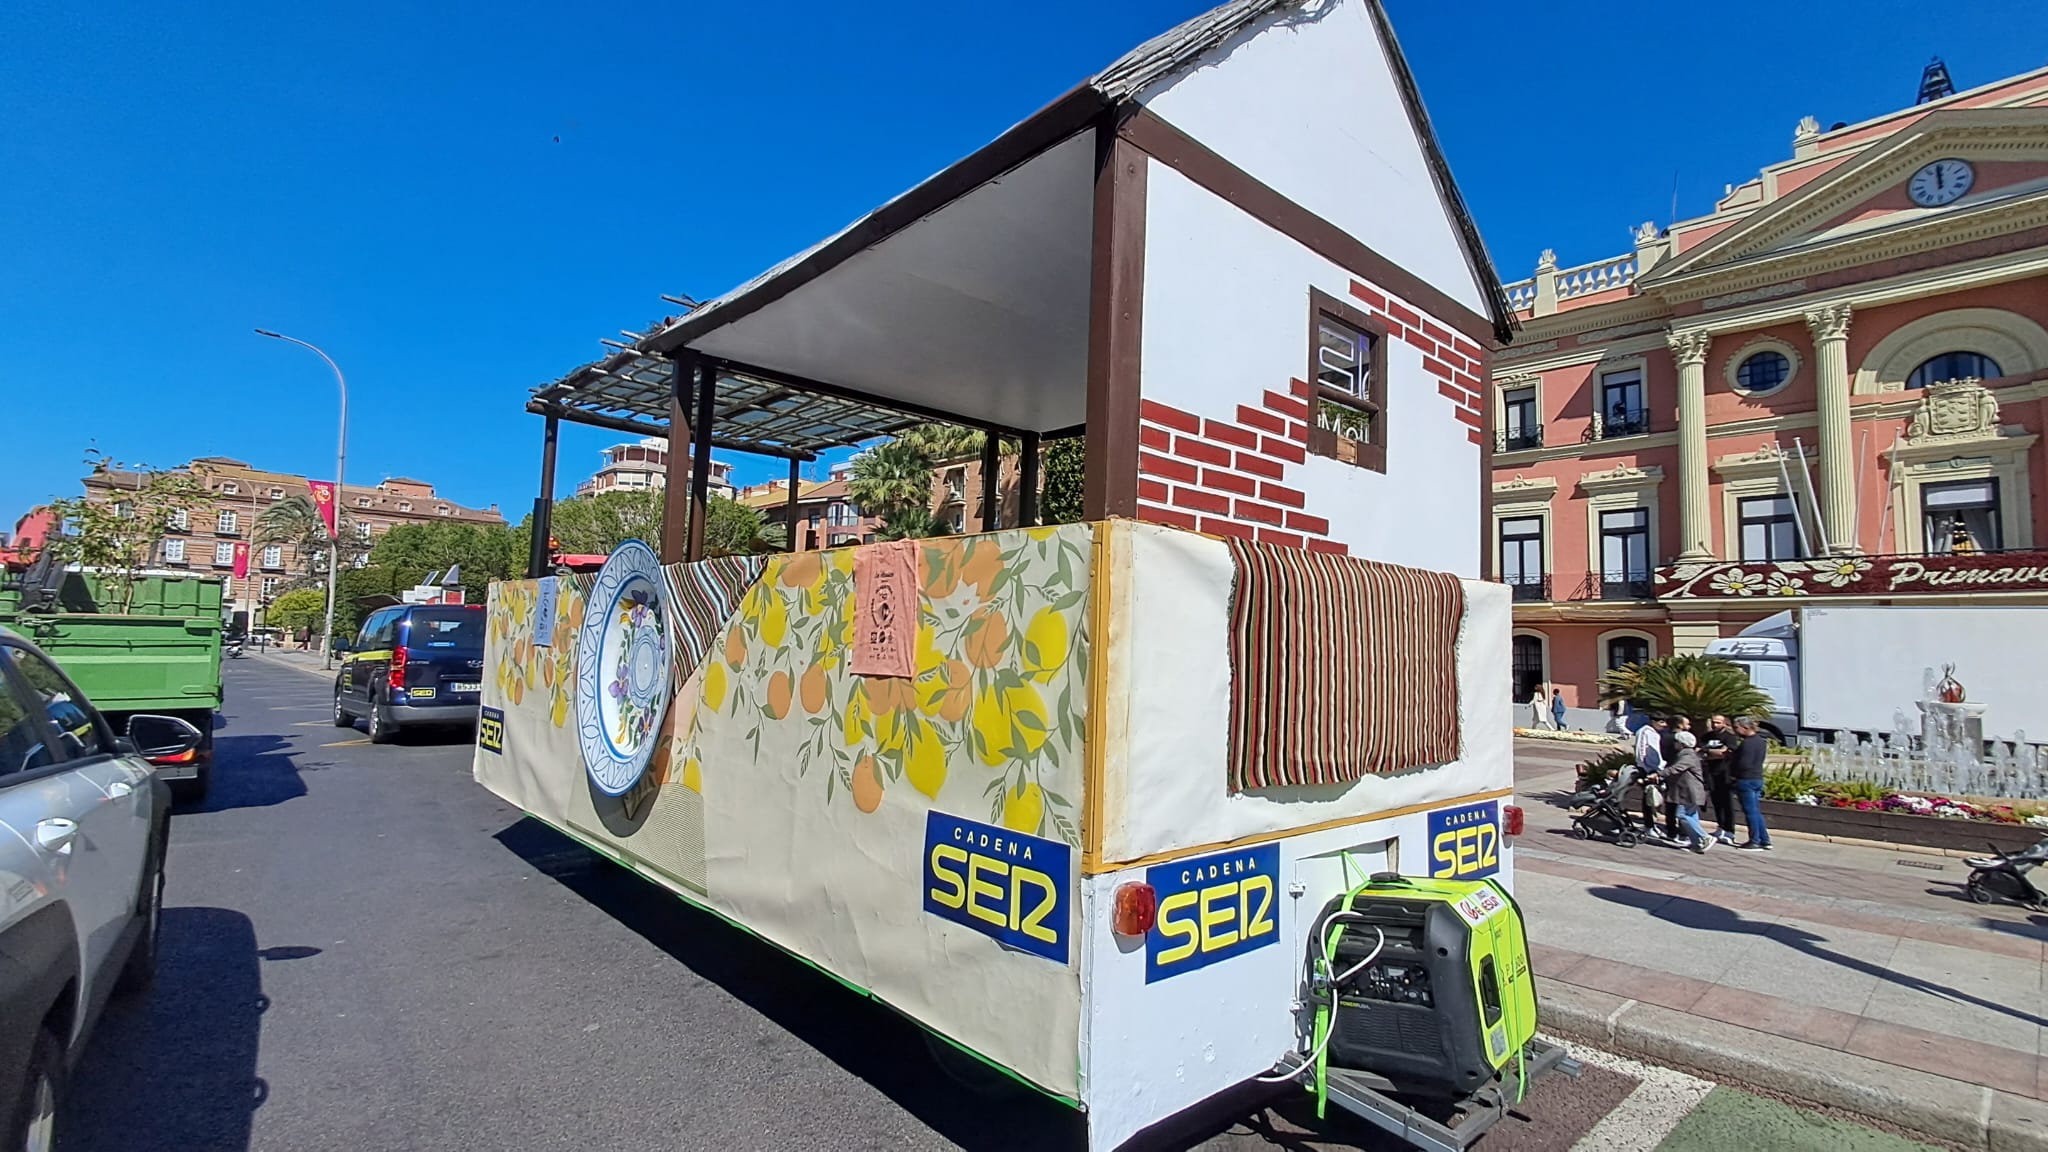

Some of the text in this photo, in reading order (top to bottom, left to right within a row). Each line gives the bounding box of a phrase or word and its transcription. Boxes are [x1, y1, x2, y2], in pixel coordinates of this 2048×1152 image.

[1445, 809, 1487, 826] CADENA
[954, 827, 1032, 860] CADENA
[1433, 822, 1497, 879] SER
[930, 843, 1058, 944] SER
[1181, 857, 1256, 885] CADENA
[1157, 874, 1274, 966] SER
